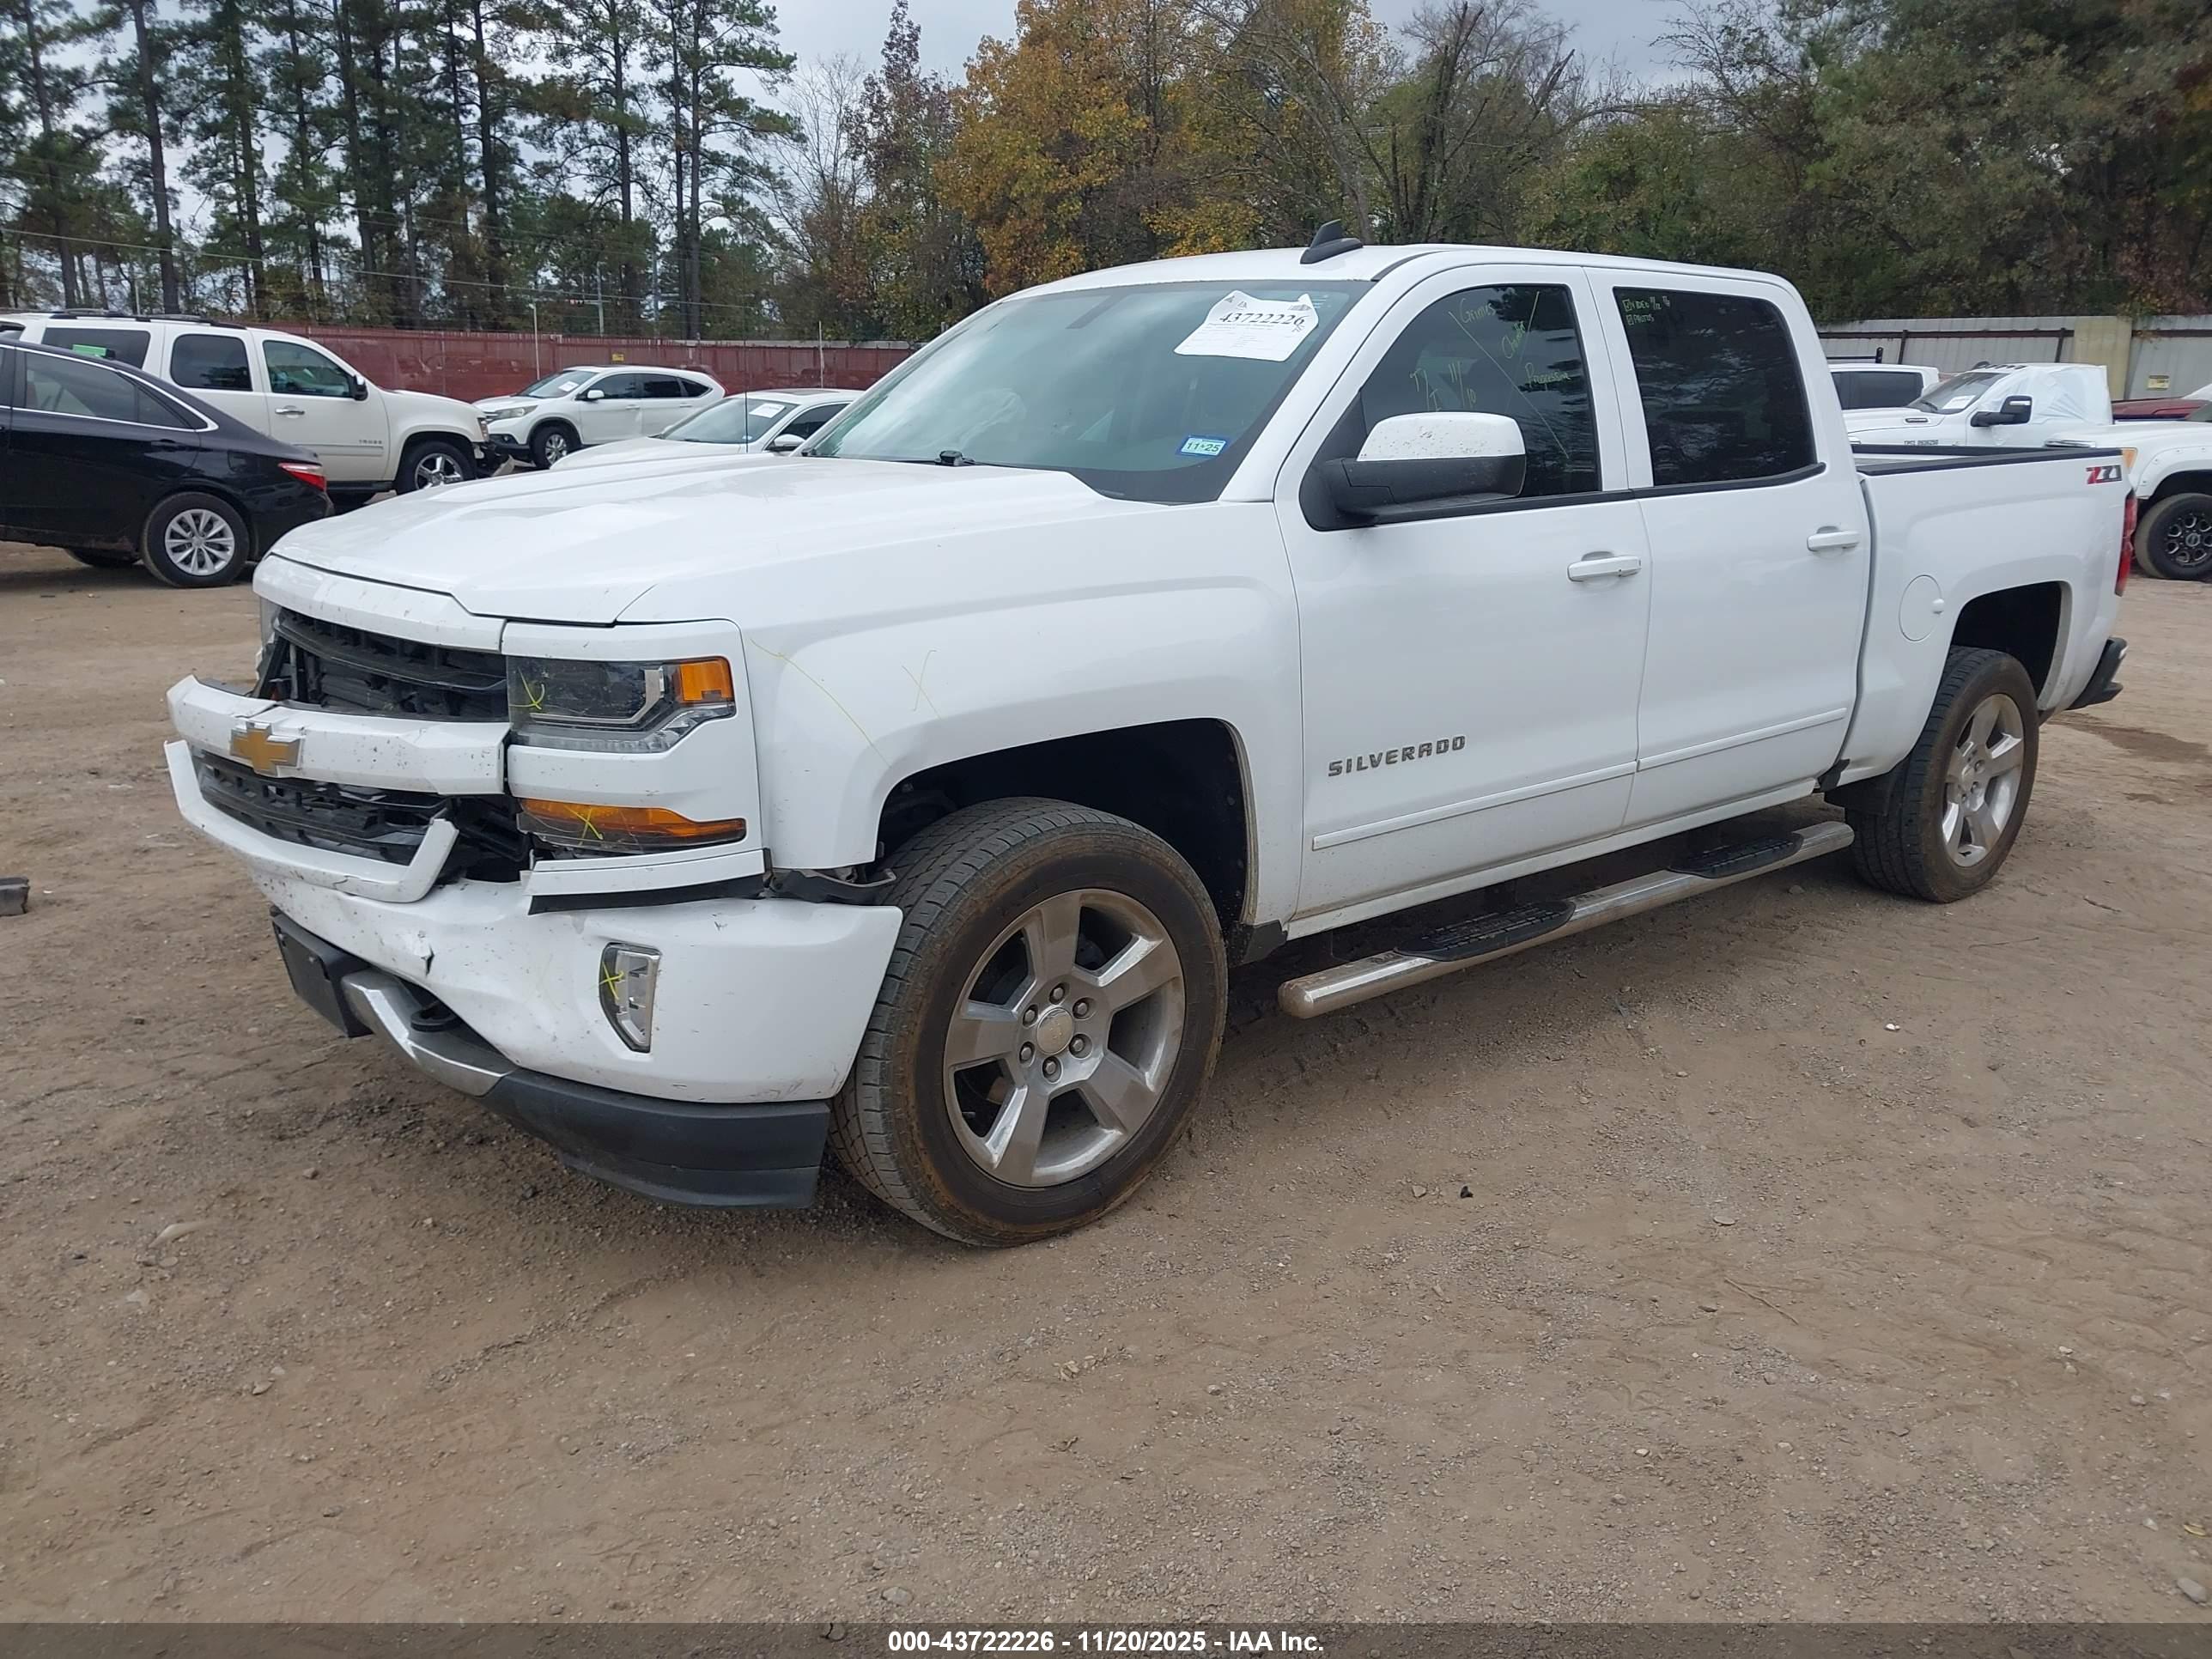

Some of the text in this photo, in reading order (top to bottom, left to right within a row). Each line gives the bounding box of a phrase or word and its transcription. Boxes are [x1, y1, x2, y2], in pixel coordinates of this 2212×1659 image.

[1219, 313, 1308, 325] 43722226
[2085, 465, 2123, 485] Z71
[1328, 735, 1466, 777] SILVERADO
